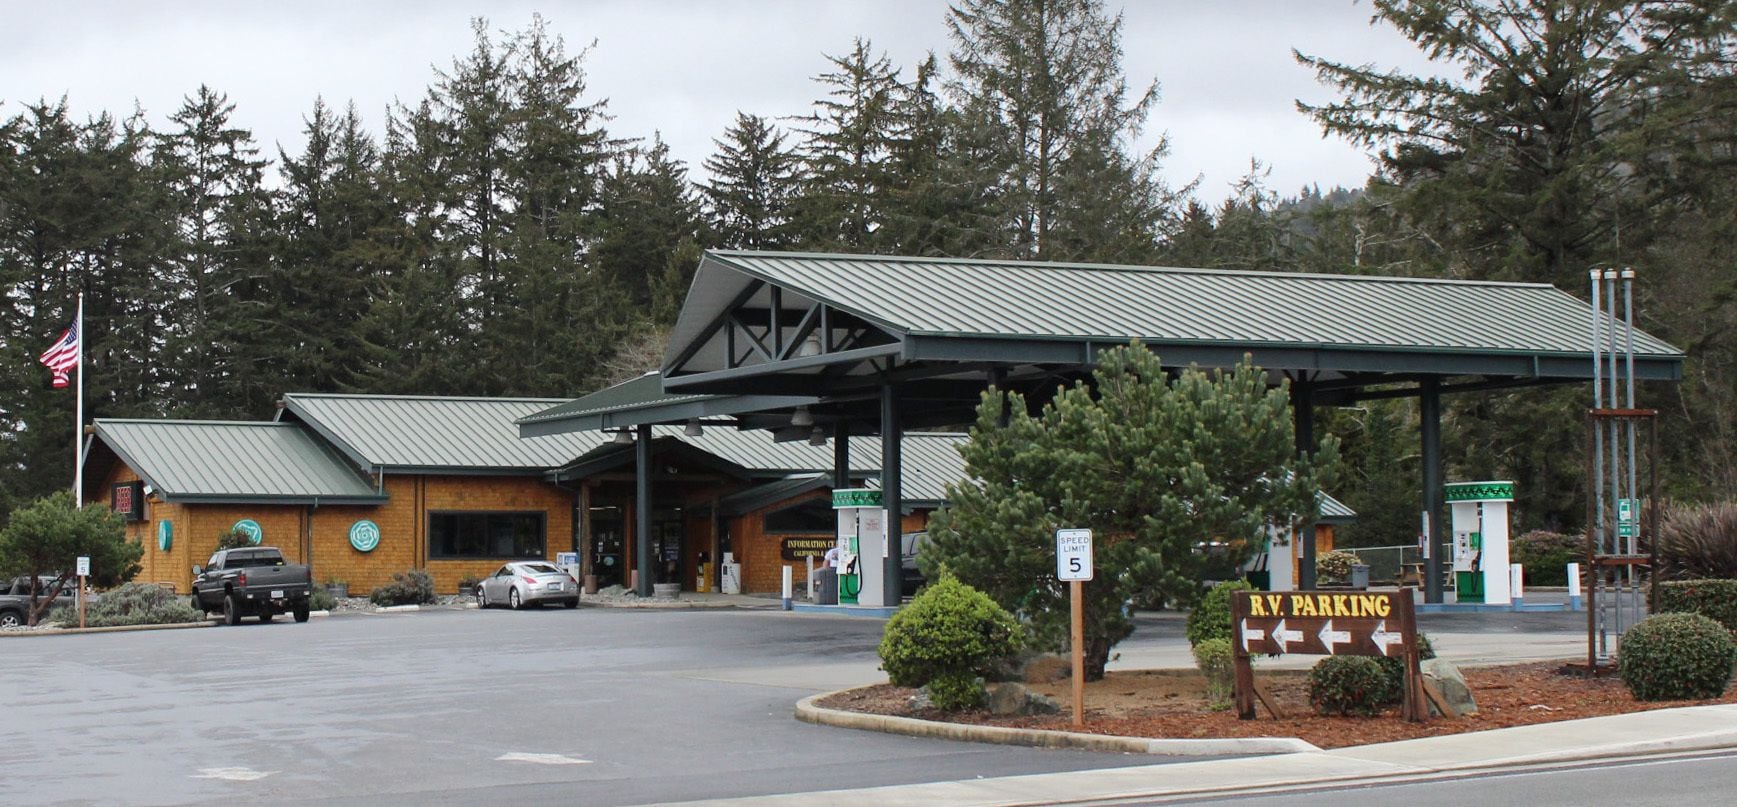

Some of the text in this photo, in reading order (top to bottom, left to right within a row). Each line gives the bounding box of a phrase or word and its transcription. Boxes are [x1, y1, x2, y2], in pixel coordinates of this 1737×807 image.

[787, 540, 827, 548] INFORMATION
[1060, 536, 1089, 544] SPEED
[1070, 557, 1081, 573] 5
[1250, 594, 1391, 617] R.V. PARKING
